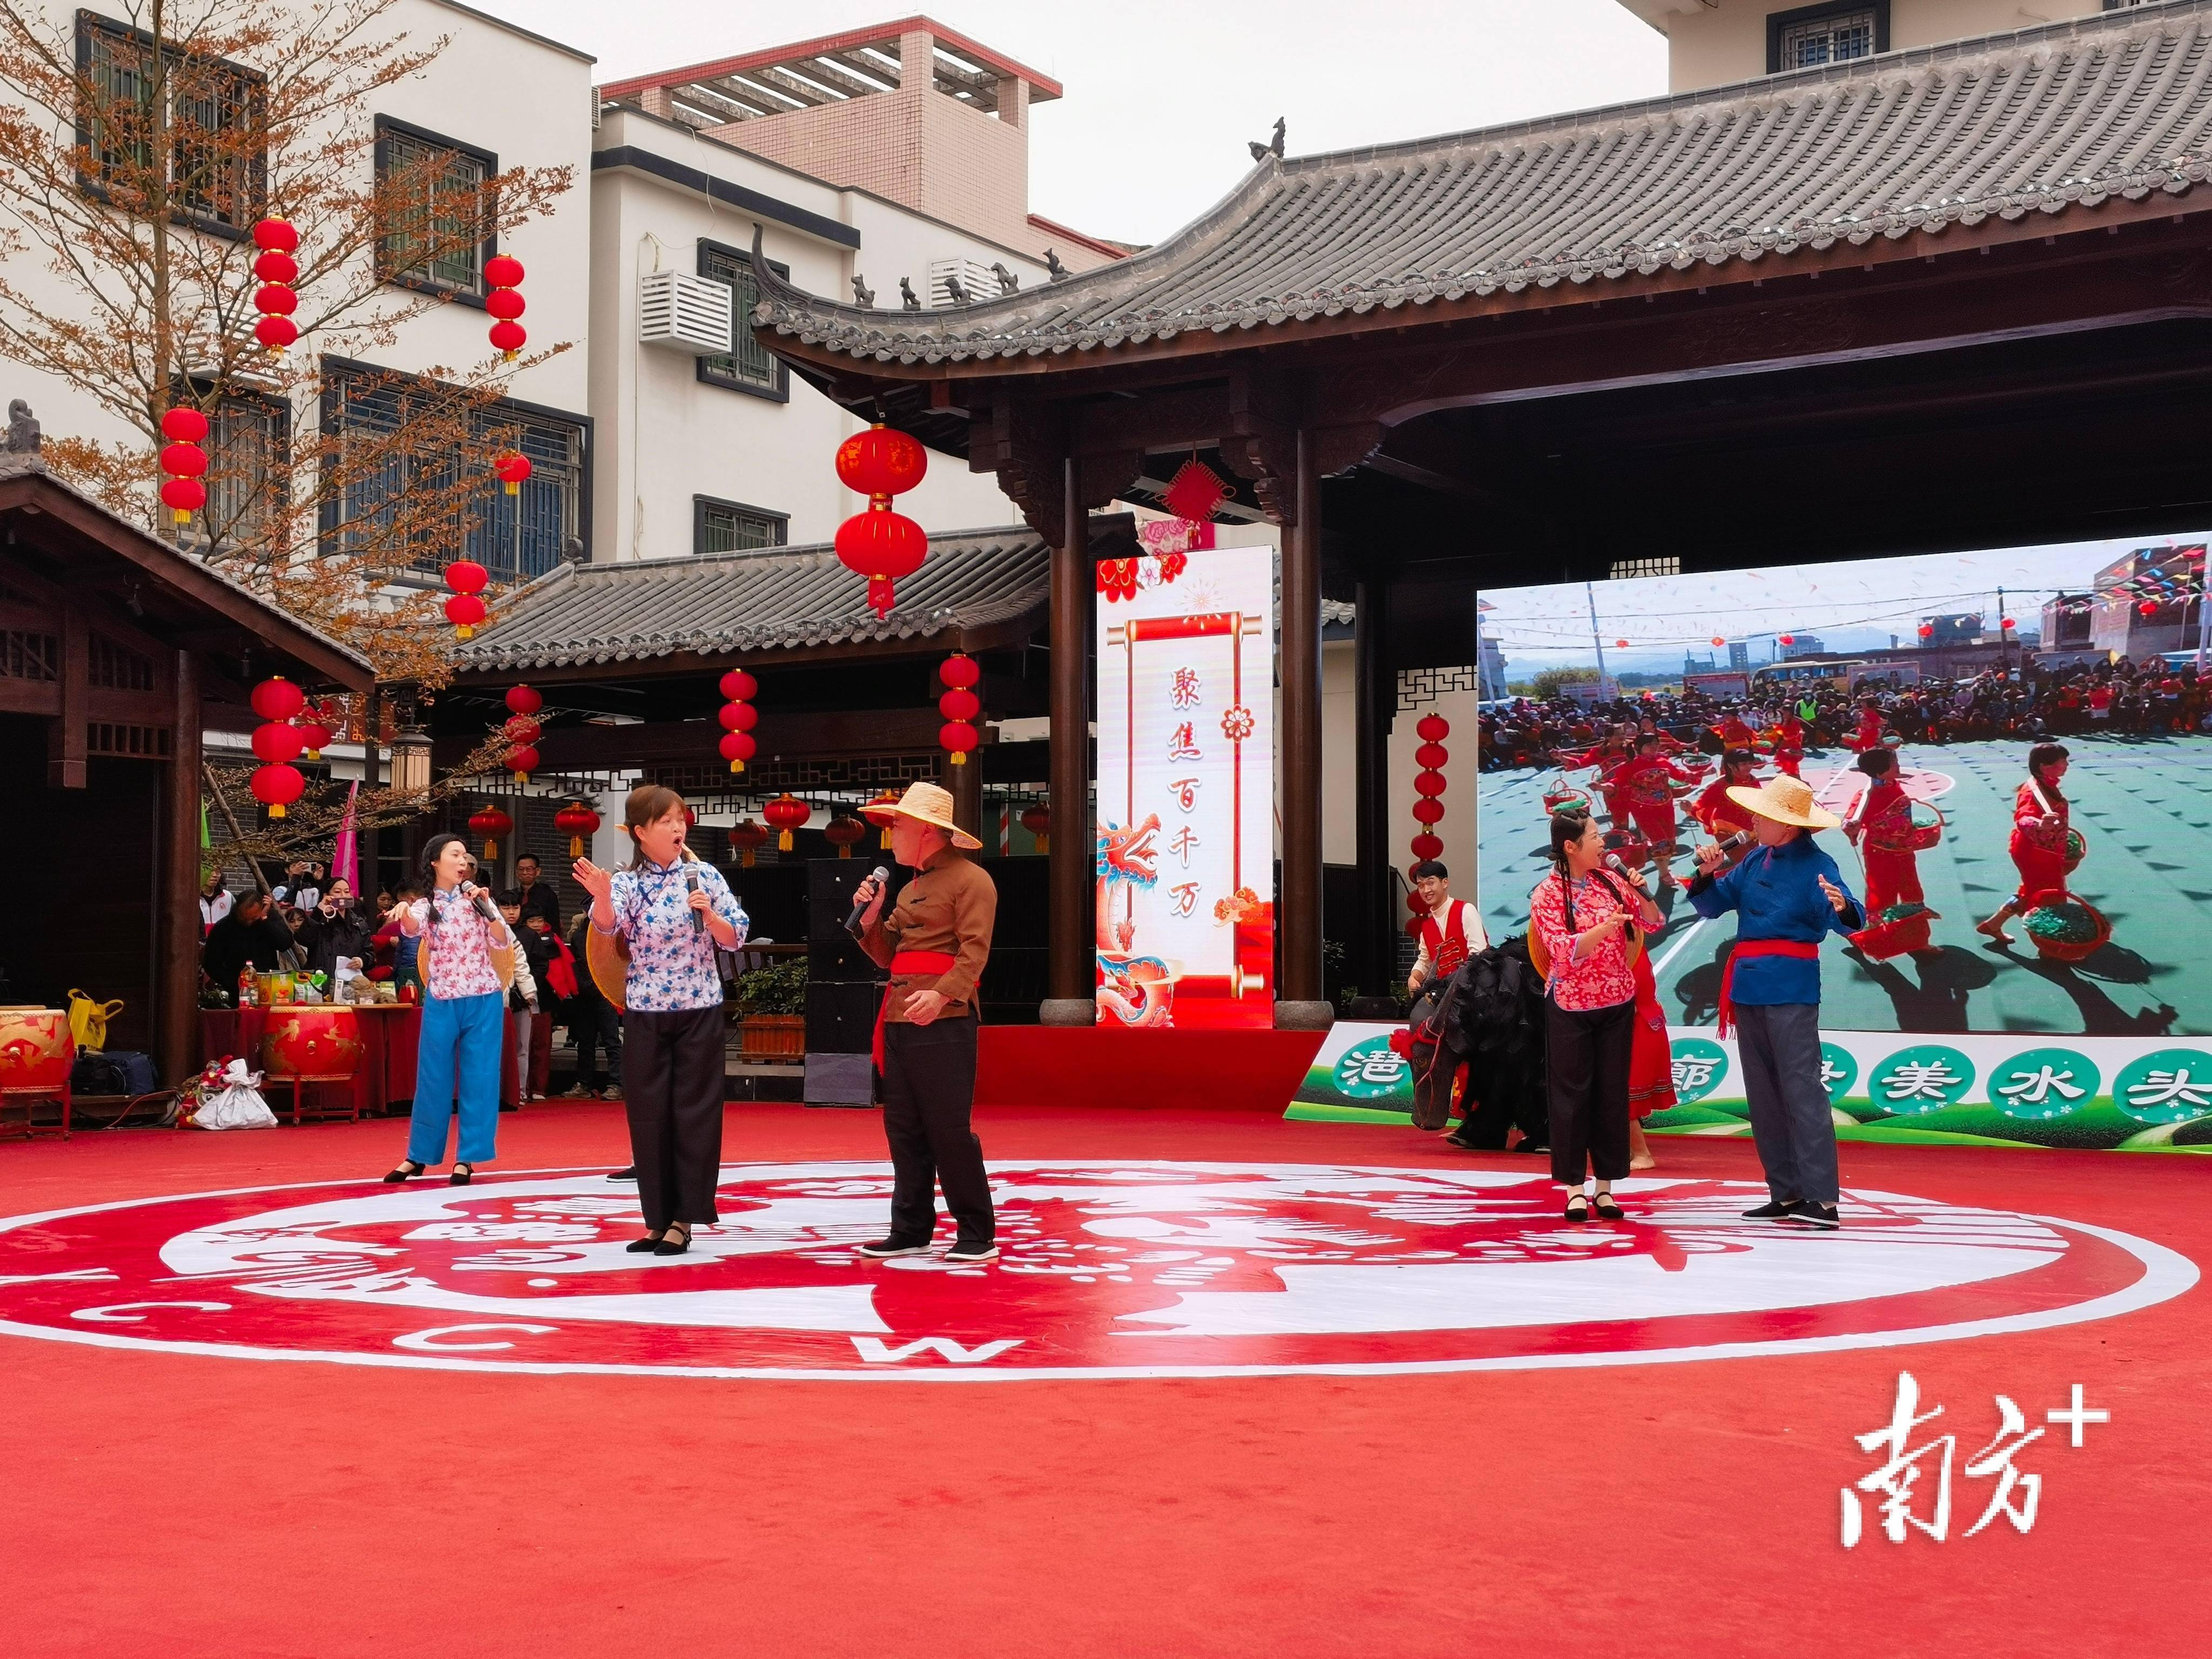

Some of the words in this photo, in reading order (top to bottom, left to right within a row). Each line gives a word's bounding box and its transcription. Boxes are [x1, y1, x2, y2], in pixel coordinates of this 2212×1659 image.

[1169, 666, 1202, 913] 聚焦百千万
